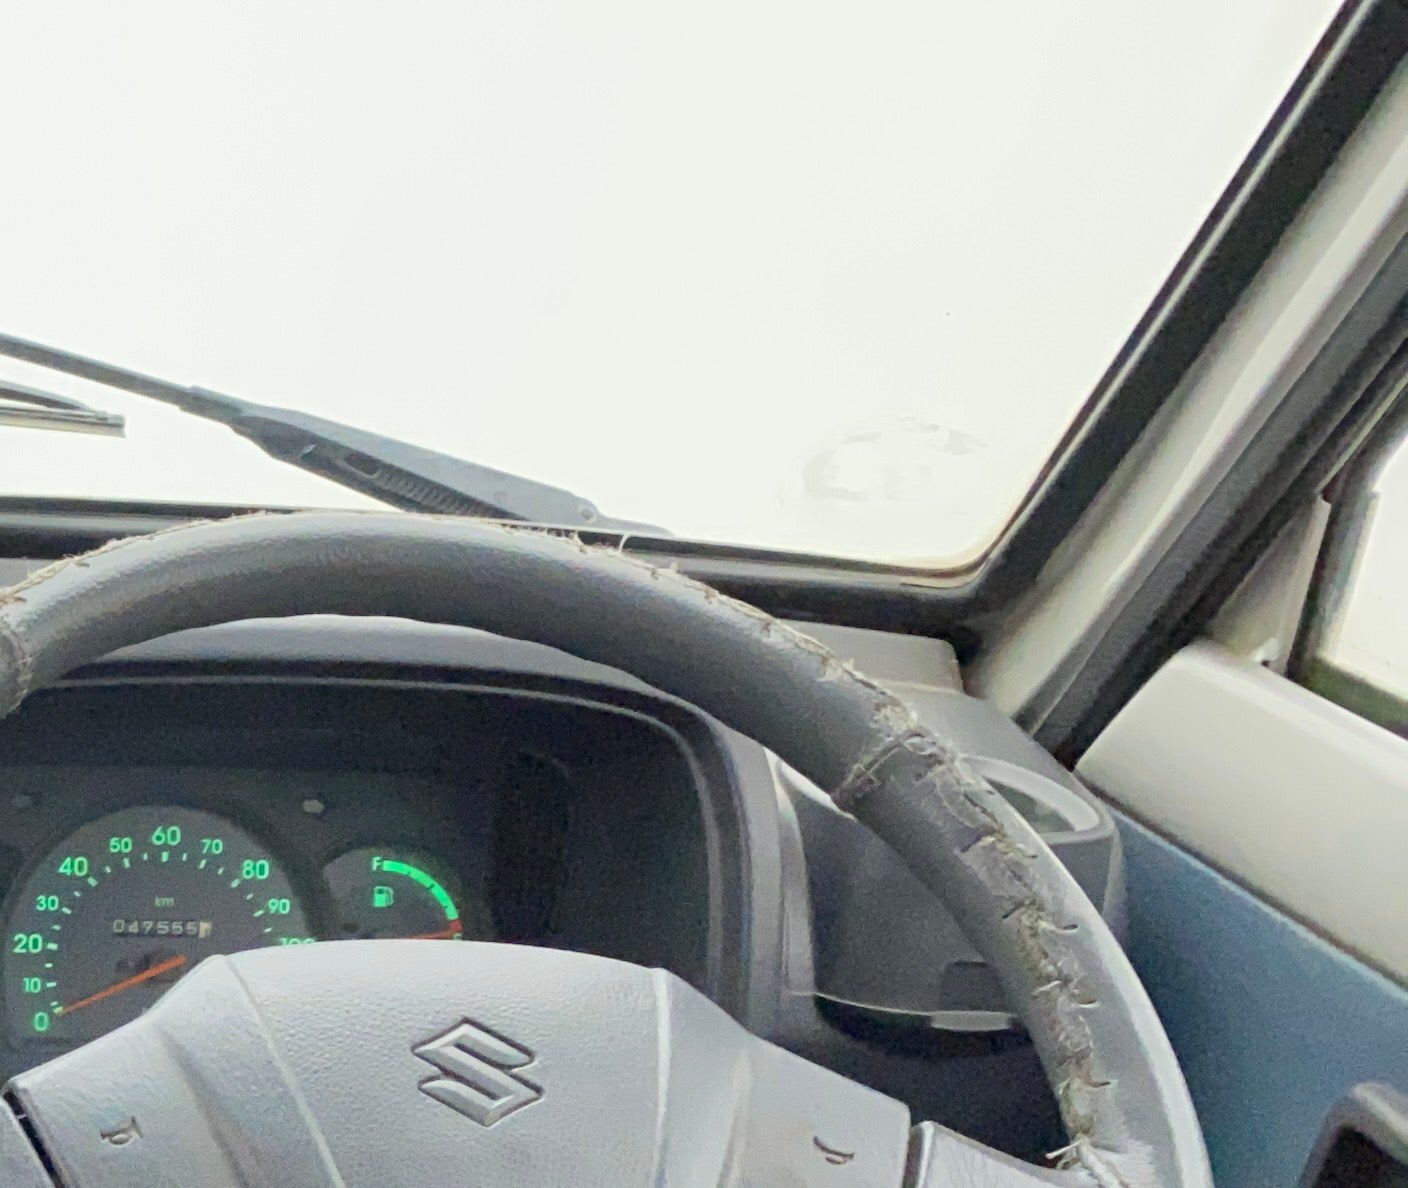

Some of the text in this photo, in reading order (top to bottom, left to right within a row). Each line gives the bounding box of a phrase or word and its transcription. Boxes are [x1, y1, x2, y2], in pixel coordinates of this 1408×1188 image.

[151, 826, 182, 846] 60
[108, 837, 133, 853] 50
[200, 839, 224, 855] 70
[58, 856, 89, 876] 40
[242, 859, 270, 880] 80
[371, 856, 382, 871] F
[35, 895, 60, 911] 30
[154, 896, 175, 907] km
[267, 898, 291, 914] 90
[12, 933, 43, 954] 20
[22, 977, 42, 993] 10
[32, 1012, 50, 1032] 0
